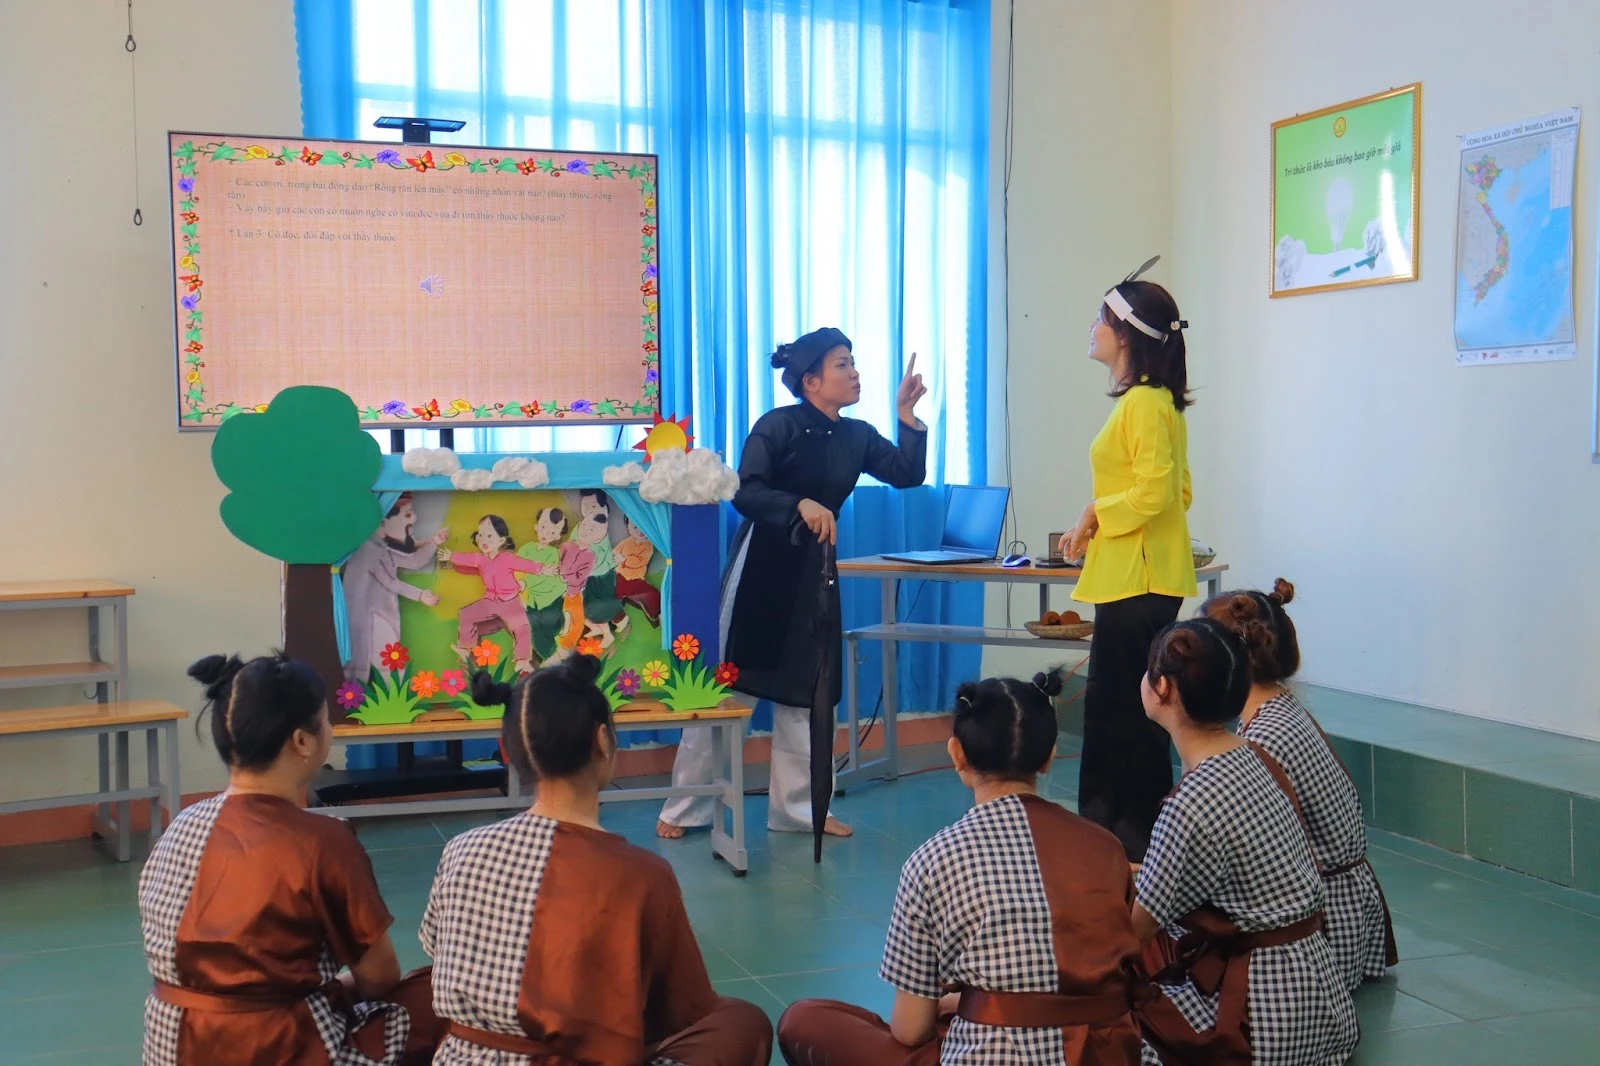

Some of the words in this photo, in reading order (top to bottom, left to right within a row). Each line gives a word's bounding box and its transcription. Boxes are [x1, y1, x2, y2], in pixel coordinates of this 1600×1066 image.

[1284, 167, 1292, 177] Tri
[1293, 164, 1306, 176] thức
[1306, 162, 1312, 172] là
[1313, 160, 1324, 171] kho
[1324, 157, 1335, 168] báu
[1336, 154, 1353, 165] không
[1354, 150, 1365, 161] bao
[1366, 146, 1376, 161] giờ
[1390, 140, 1402, 156] giá
